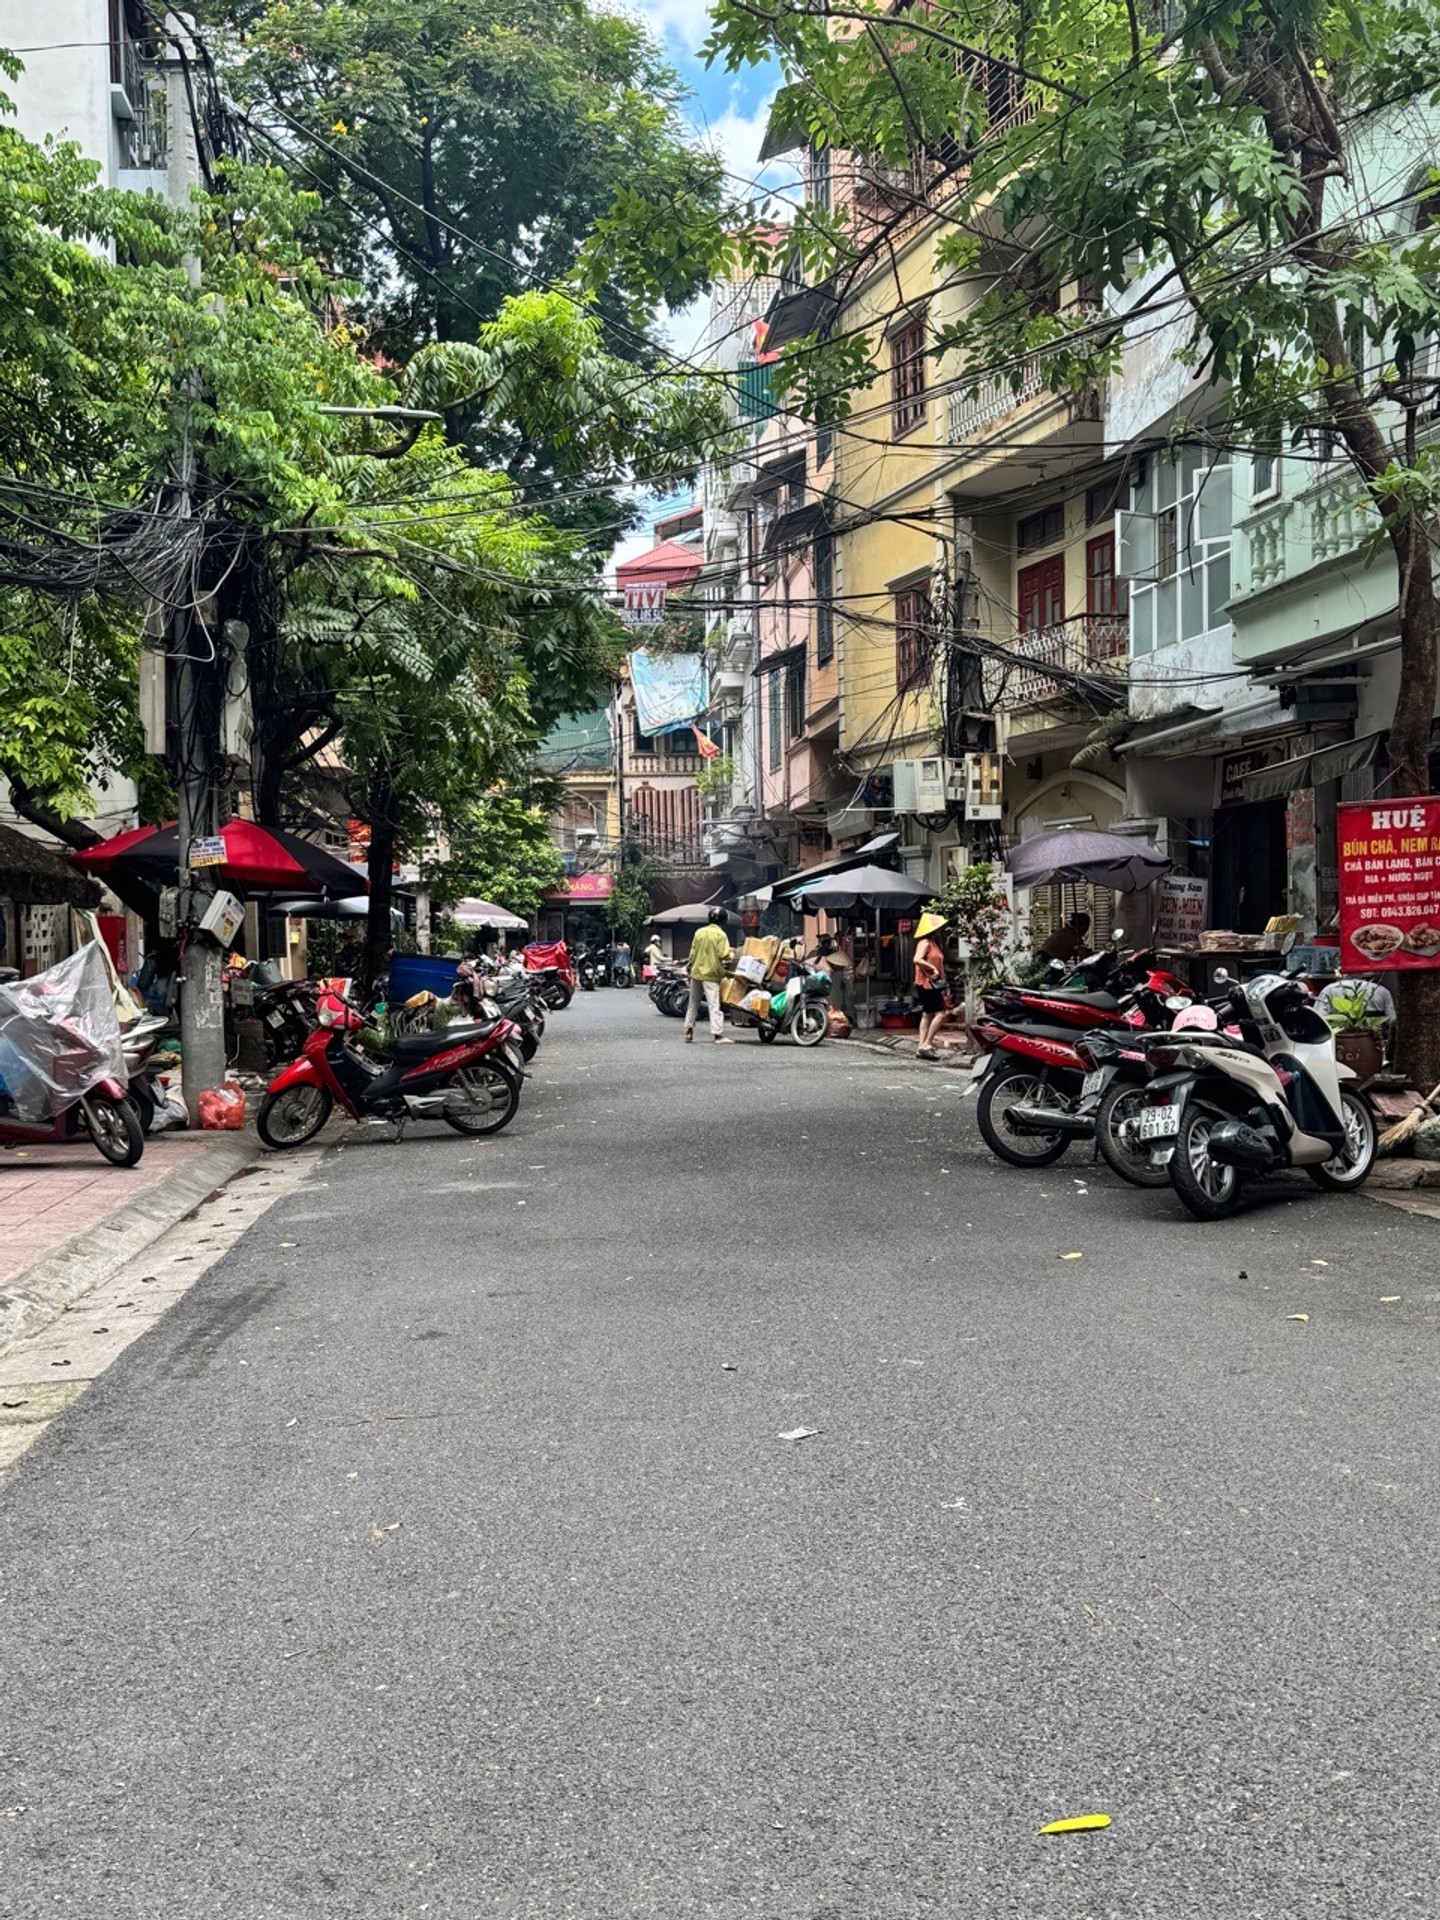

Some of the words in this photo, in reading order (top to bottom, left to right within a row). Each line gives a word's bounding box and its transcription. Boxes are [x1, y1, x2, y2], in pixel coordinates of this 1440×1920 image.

[1371, 804, 1426, 832] HUỆ
[1343, 838, 1368, 857] BÚN
[1401, 837, 1428, 853] NEM
[1145, 1107, 1173, 1123] 29-02
